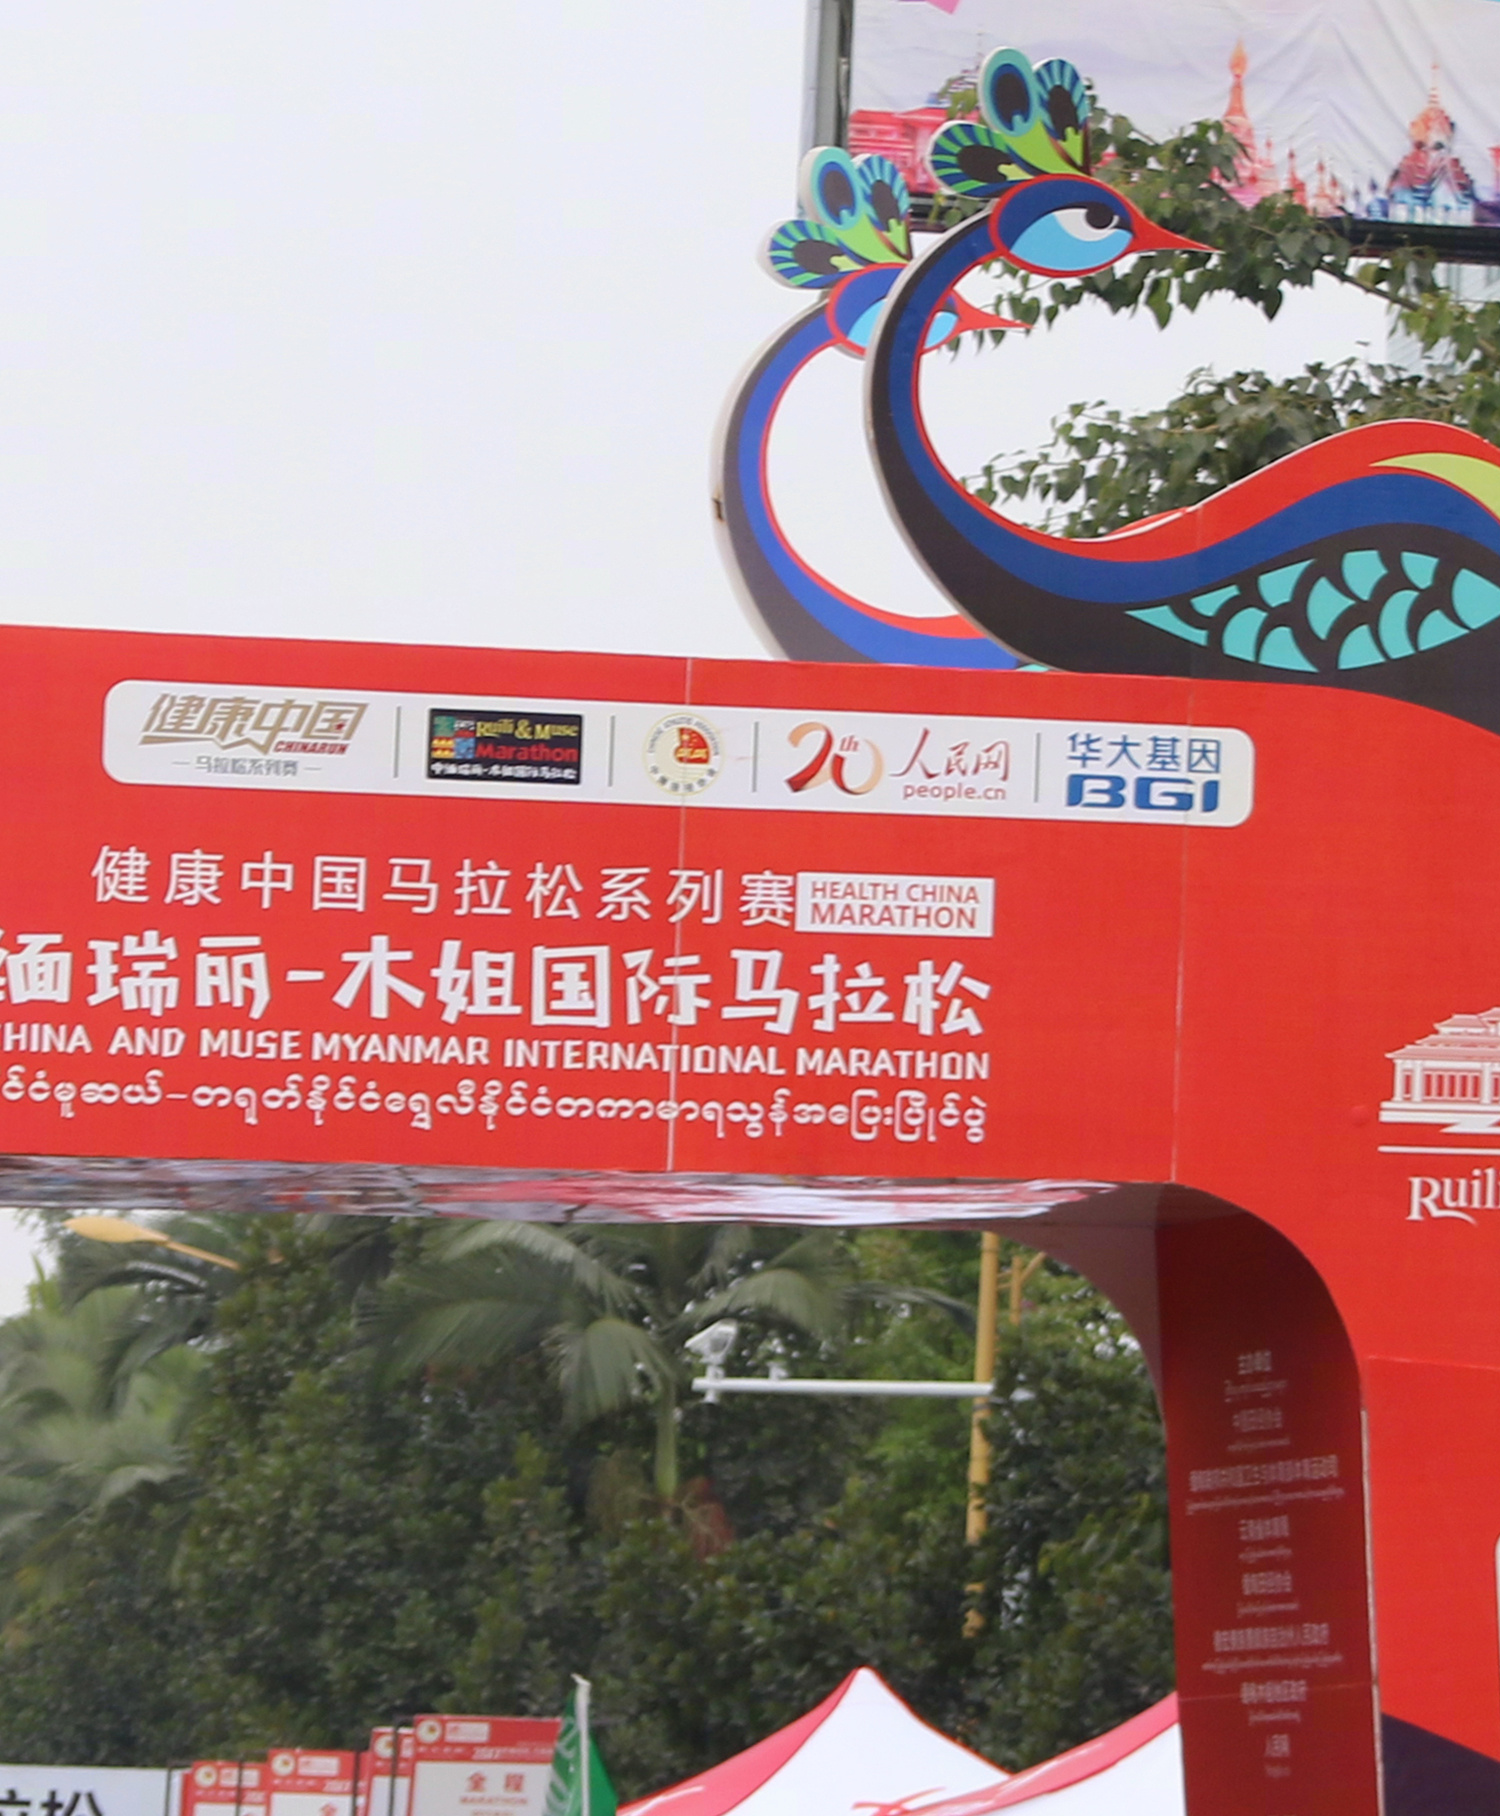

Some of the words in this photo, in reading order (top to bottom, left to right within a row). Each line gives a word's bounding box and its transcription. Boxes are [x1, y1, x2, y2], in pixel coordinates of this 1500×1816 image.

[138, 694, 368, 753] 健康中国
[476, 717, 514, 738] Ruili
[514, 719, 534, 740] &
[534, 723, 579, 740] Muse
[273, 739, 349, 755] CHINARUN
[475, 743, 579, 763] Marathon
[888, 727, 1011, 783] 人民网
[1066, 731, 1222, 774] 华大基因
[902, 781, 1007, 802] people.cn
[1065, 773, 1221, 813] BGI
[90, 844, 796, 928] 健康中国马拉松系列赛
[810, 880, 899, 902] HEALTH
[905, 884, 981, 905] CHINA
[810, 902, 978, 929] MARATHON
[107, 1025, 187, 1059] AND
[199, 1028, 303, 1061] MUSE
[312, 1031, 490, 1066] MYANMAR
[503, 1038, 786, 1077] INTERNATIONAL
[795, 1046, 990, 1081] MARATHON
